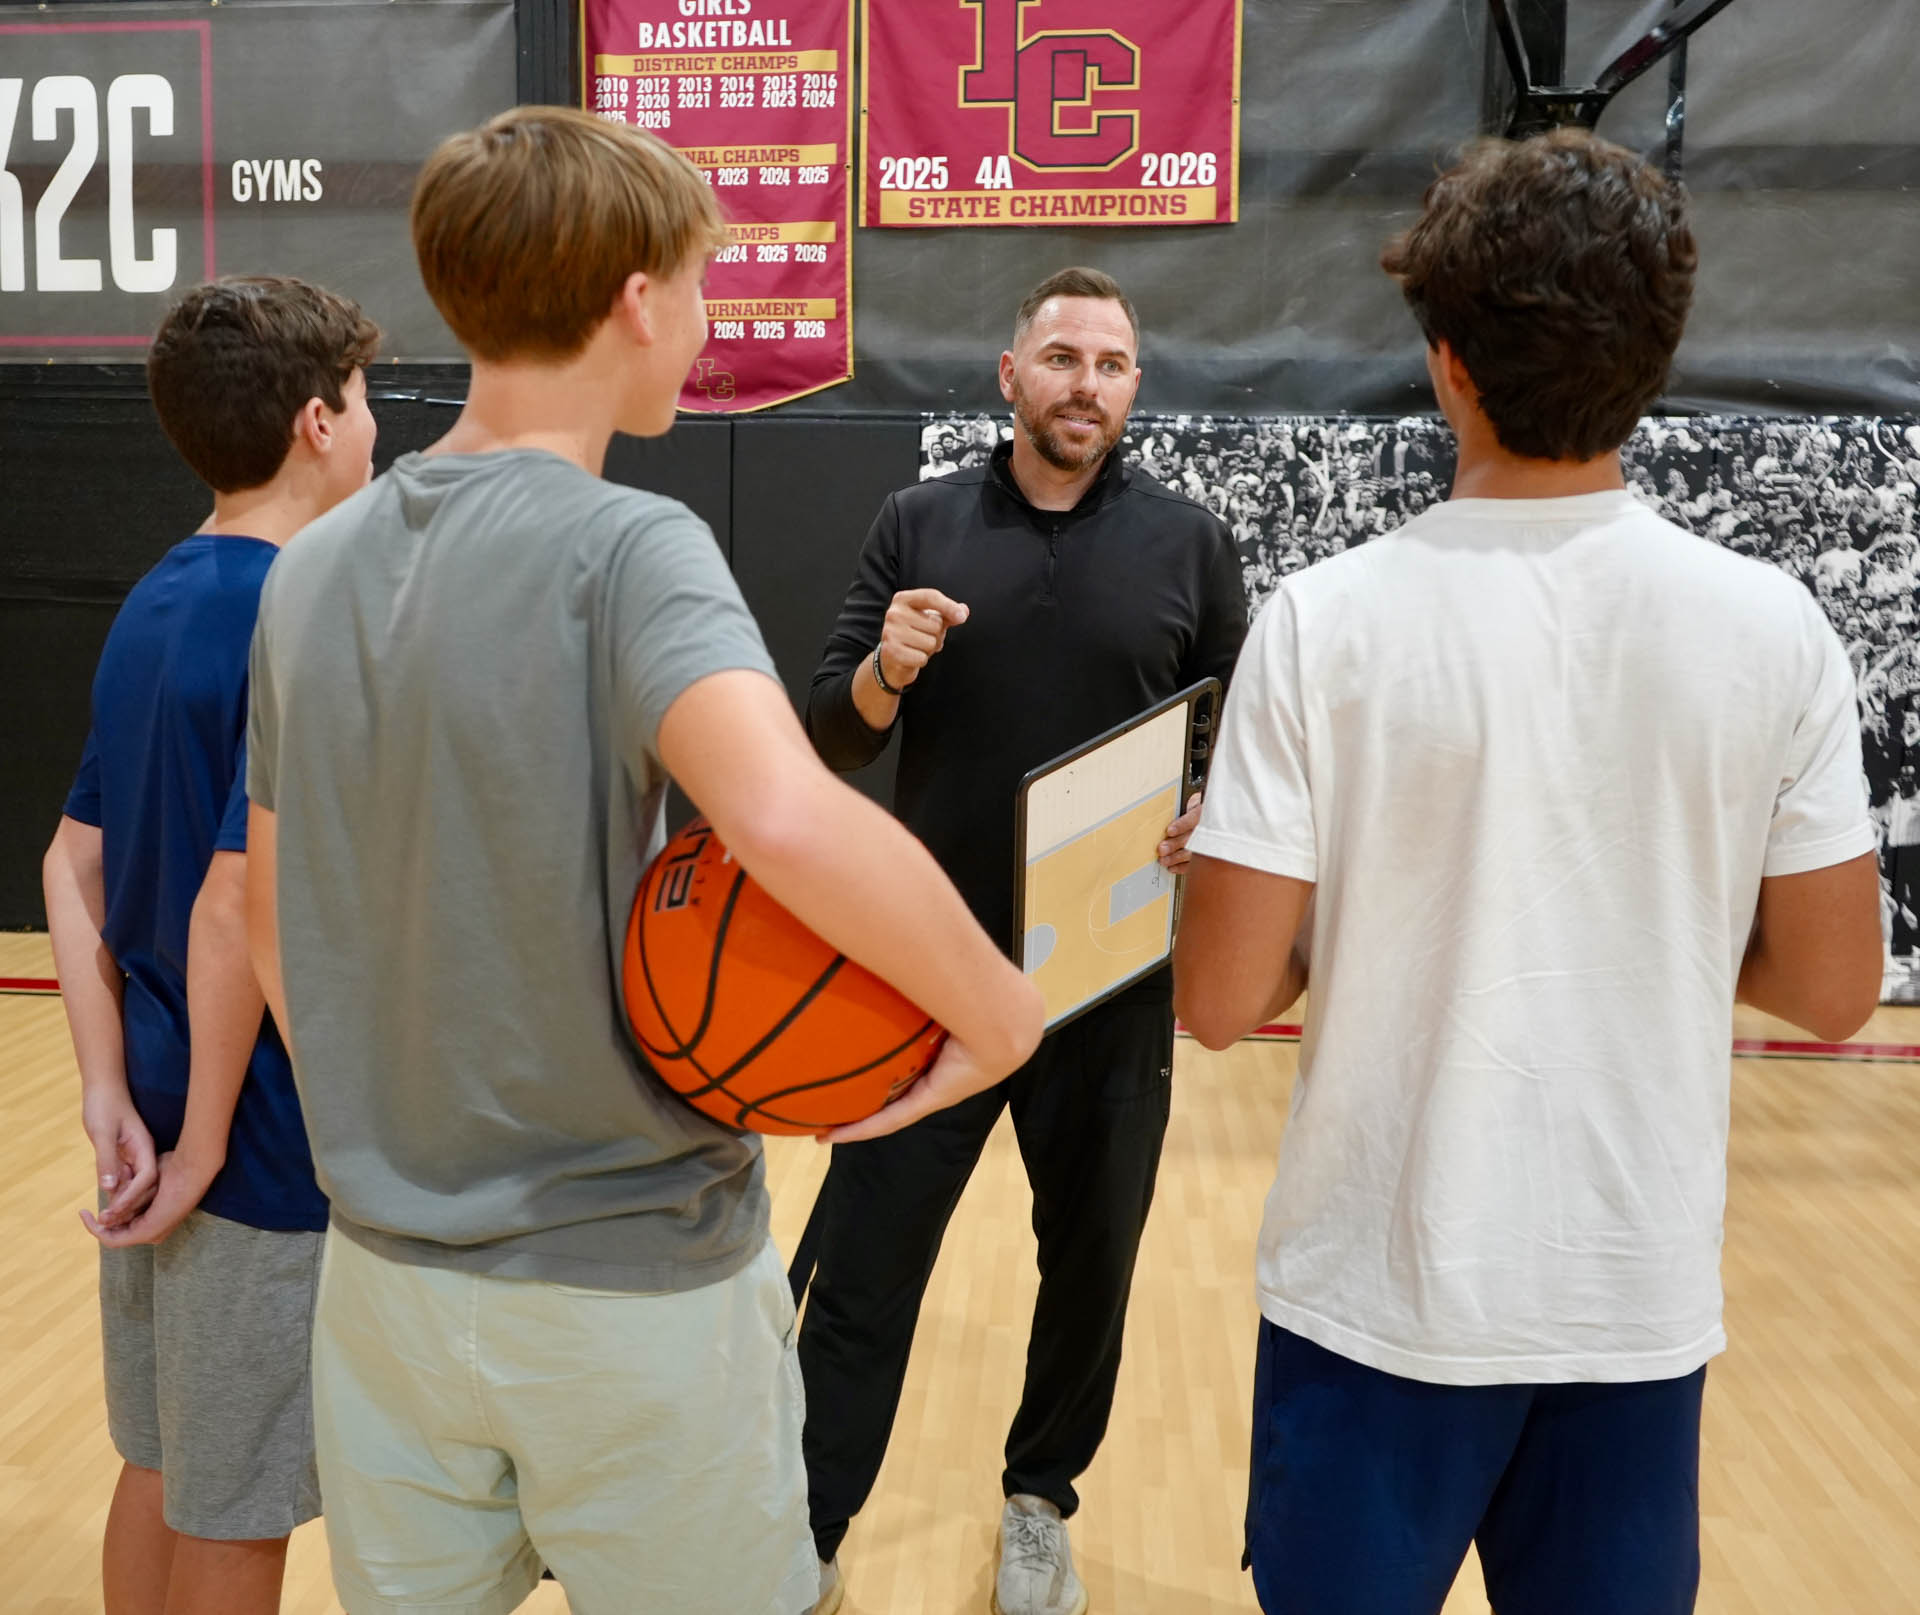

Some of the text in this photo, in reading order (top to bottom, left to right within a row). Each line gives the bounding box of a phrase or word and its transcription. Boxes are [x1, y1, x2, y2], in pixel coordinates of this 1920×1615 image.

[678, 0, 752, 16] GIRLS
[639, 19, 792, 48] BASKETBALL
[633, 55, 798, 73] DISTRICT CHAMPS
[595, 73, 838, 93] 2010 2012 2013 2014 2015 2016
[595, 89, 836, 109] 2019 2020 2021 2022 2023 2024
[637, 110, 671, 129] 2026
[723, 148, 801, 163] CHAMPS
[232, 159, 323, 202] GYMS
[717, 167, 749, 186] 2023
[759, 166, 791, 186] 2024
[798, 166, 829, 184] 2025
[879, 152, 1217, 190] 2025 4A 2026
[908, 194, 1188, 218] STATE CHAMPIONS
[715, 243, 827, 263] 2024 2025 2026
[706, 302, 809, 317] URNAMENT
[713, 320, 826, 339] 2024 2025 2026
